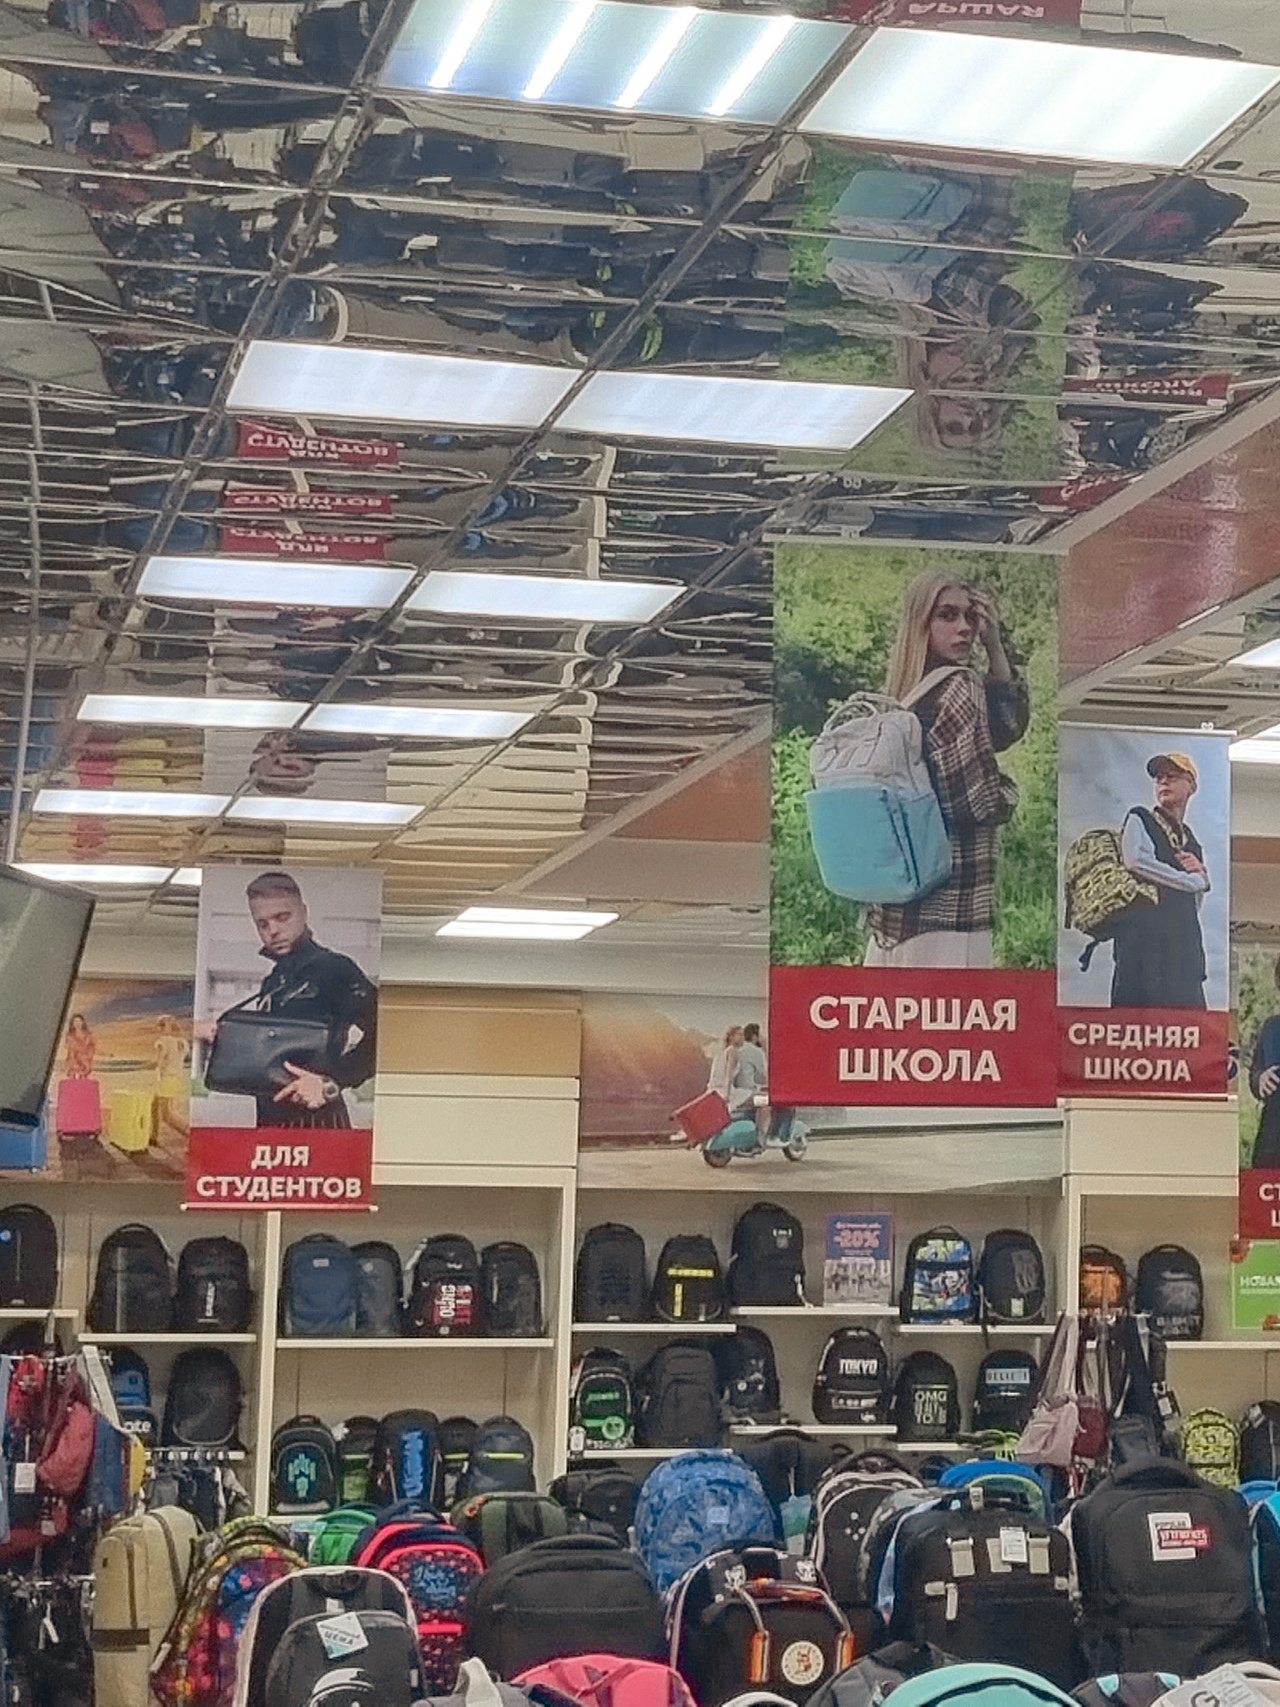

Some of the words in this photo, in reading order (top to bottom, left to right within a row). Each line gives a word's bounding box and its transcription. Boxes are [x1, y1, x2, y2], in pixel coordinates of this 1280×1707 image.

[809, 995, 1017, 1032] СТАРШАЯ
[1068, 1022, 1200, 1051] СРЕДНЯЯ
[838, 1047, 1001, 1082] ШКОЛА
[1084, 1057, 1192, 1082] ШКОЛА
[251, 1145, 310, 1170] ДЛЯ
[196, 1176, 362, 1201] СТУДЕНТОВ
[833, 1229, 880, 1249] -20%
[838, 1358, 879, 1375] TOKYO
